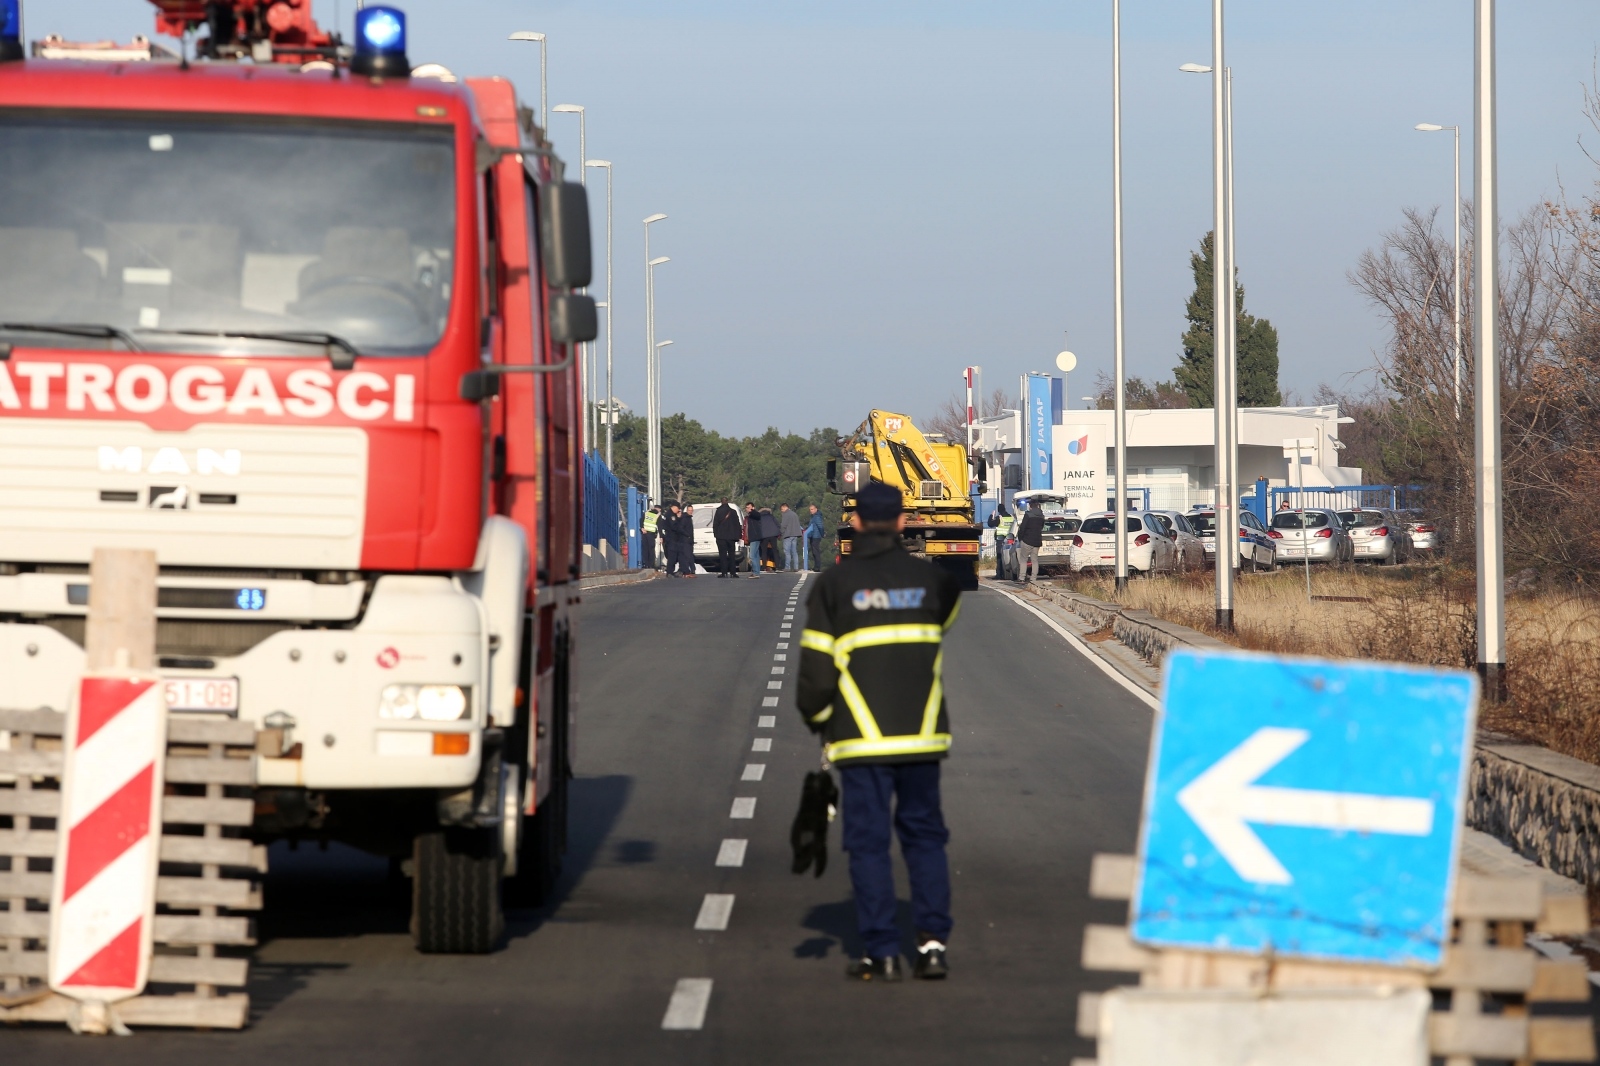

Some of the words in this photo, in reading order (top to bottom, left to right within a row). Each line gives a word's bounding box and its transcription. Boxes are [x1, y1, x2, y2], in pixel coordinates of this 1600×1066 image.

[885, 418, 902, 430] PM
[1036, 398, 1045, 444] JANAF
[97, 445, 242, 475] MAN
[1063, 470, 1095, 481] JANAF
